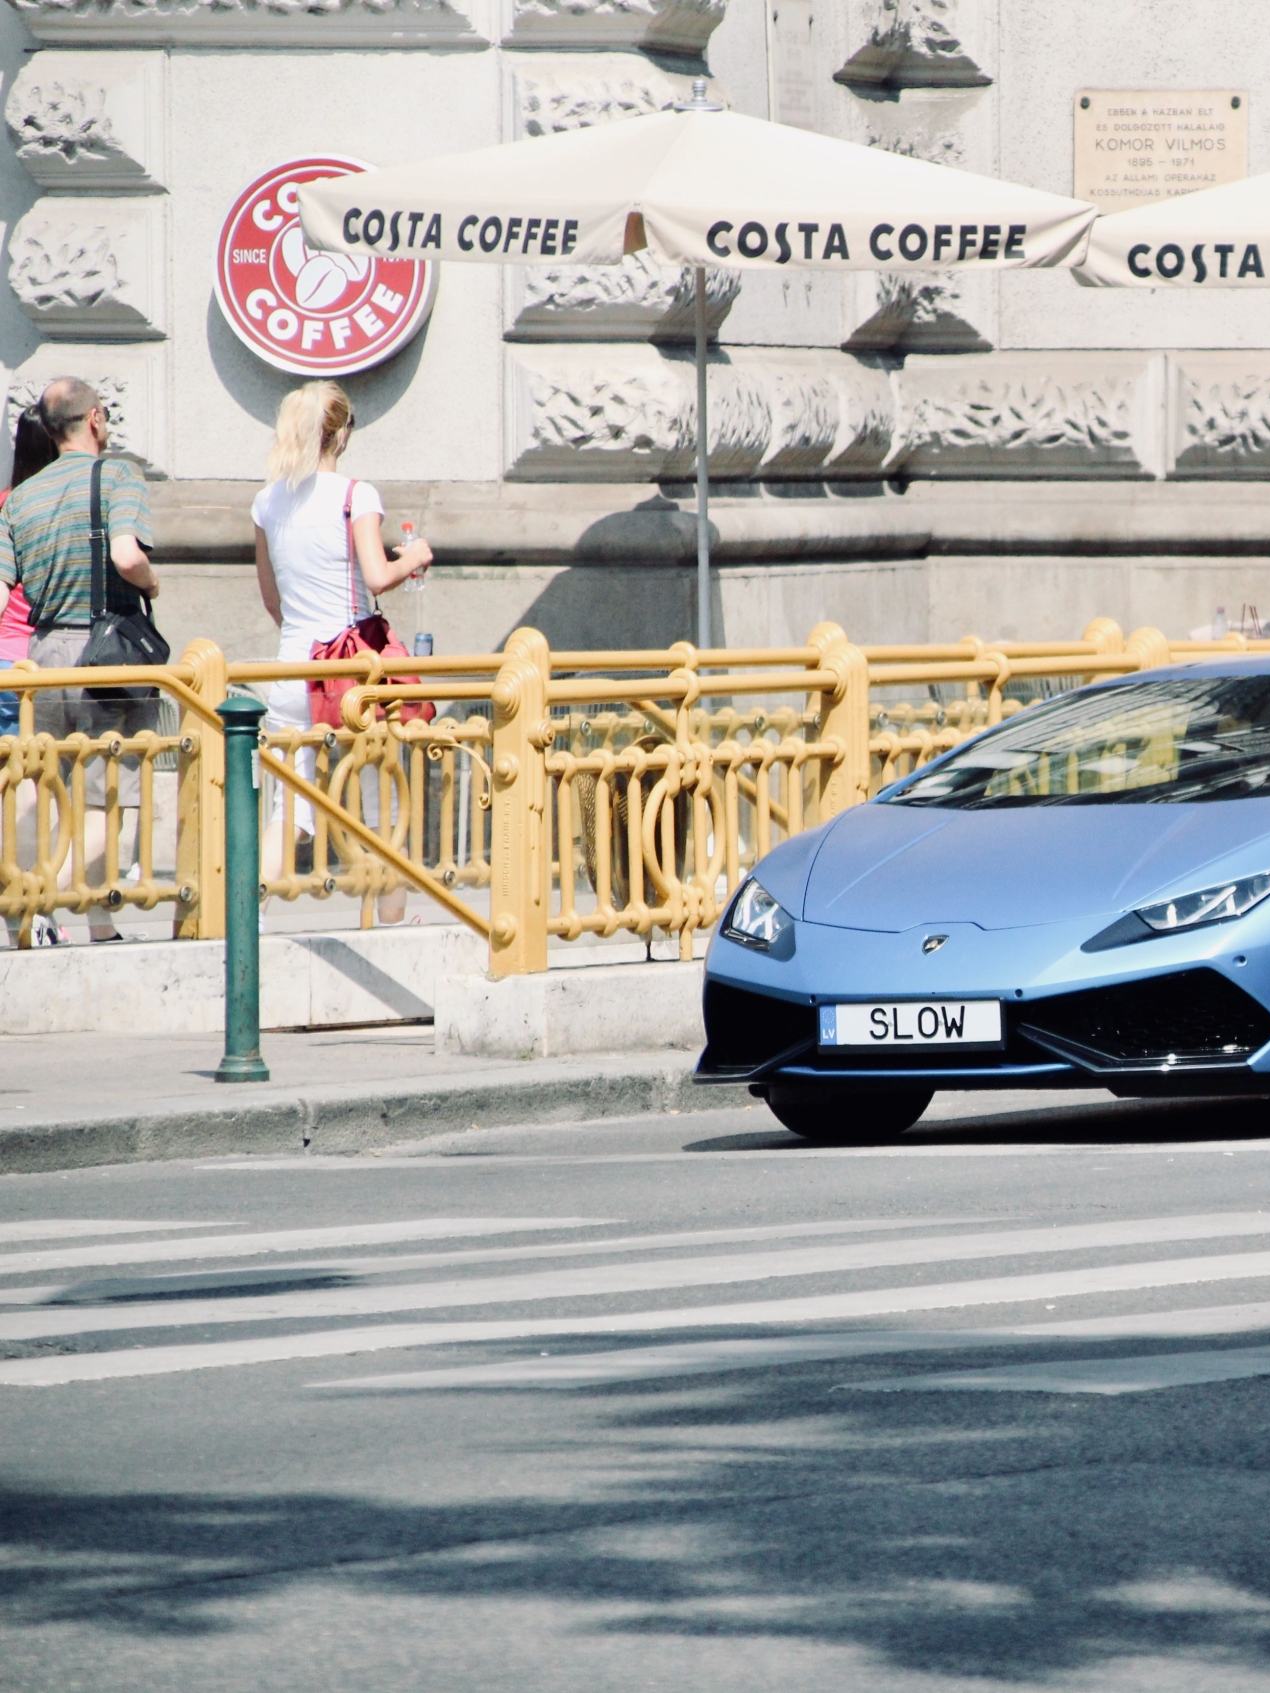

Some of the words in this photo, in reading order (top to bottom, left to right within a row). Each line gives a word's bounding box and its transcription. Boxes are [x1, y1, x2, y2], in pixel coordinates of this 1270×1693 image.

[1107, 108, 1137, 116] EBBEN
[1141, 108, 1148, 116] A
[1114, 123, 1172, 131] DOLGOZOTT
[1095, 138, 1154, 151] KOMOR
[1165, 138, 1226, 151] VILMOS
[1127, 158, 1153, 167] 1895
[343, 207, 441, 252] COSTA
[457, 214, 579, 256] COFFEE
[706, 220, 850, 264] COSTA
[869, 223, 1027, 261] COFFEE
[232, 249, 267, 264] SINCE
[1127, 243, 1265, 283] COSTA
[245, 283, 404, 350] COFFEE
[870, 1005, 966, 1040] SLOW
[822, 1029, 836, 1040] LV
